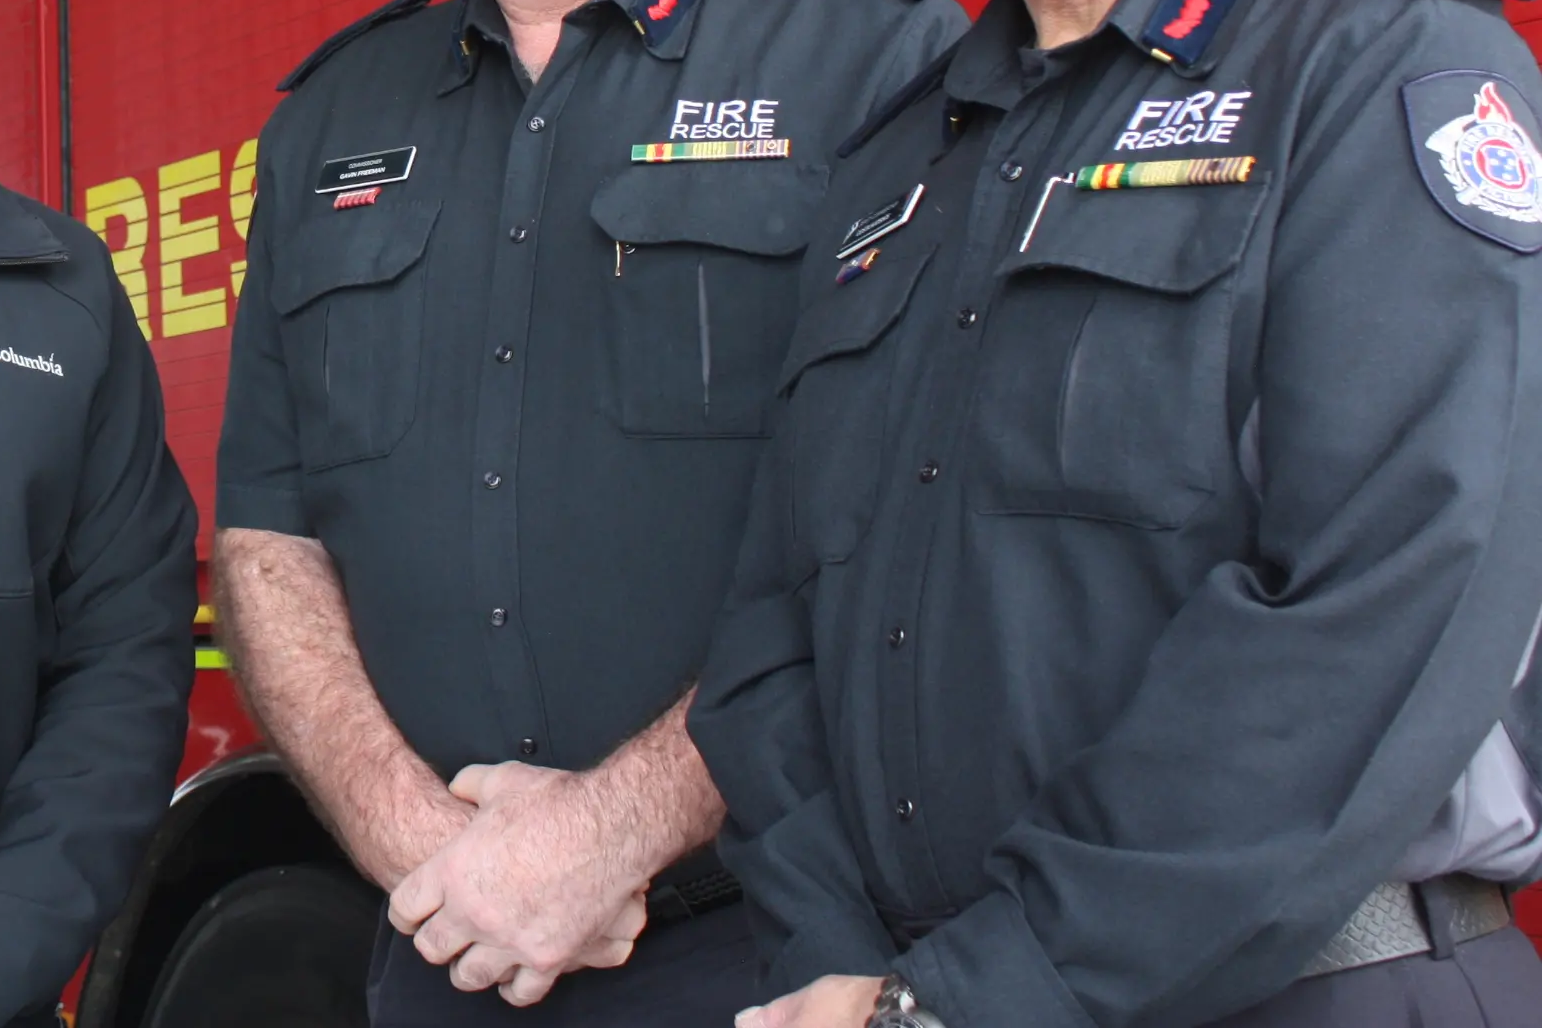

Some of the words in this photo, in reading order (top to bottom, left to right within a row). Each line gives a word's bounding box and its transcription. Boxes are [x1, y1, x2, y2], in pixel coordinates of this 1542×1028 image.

[674, 99, 779, 123] FIRE
[1127, 91, 1252, 130] FIRE
[670, 123, 774, 139] RESCUE
[1114, 122, 1236, 150] RESCUE
[339, 171, 357, 179] GAVIN
[358, 167, 386, 176] FREEMAN
